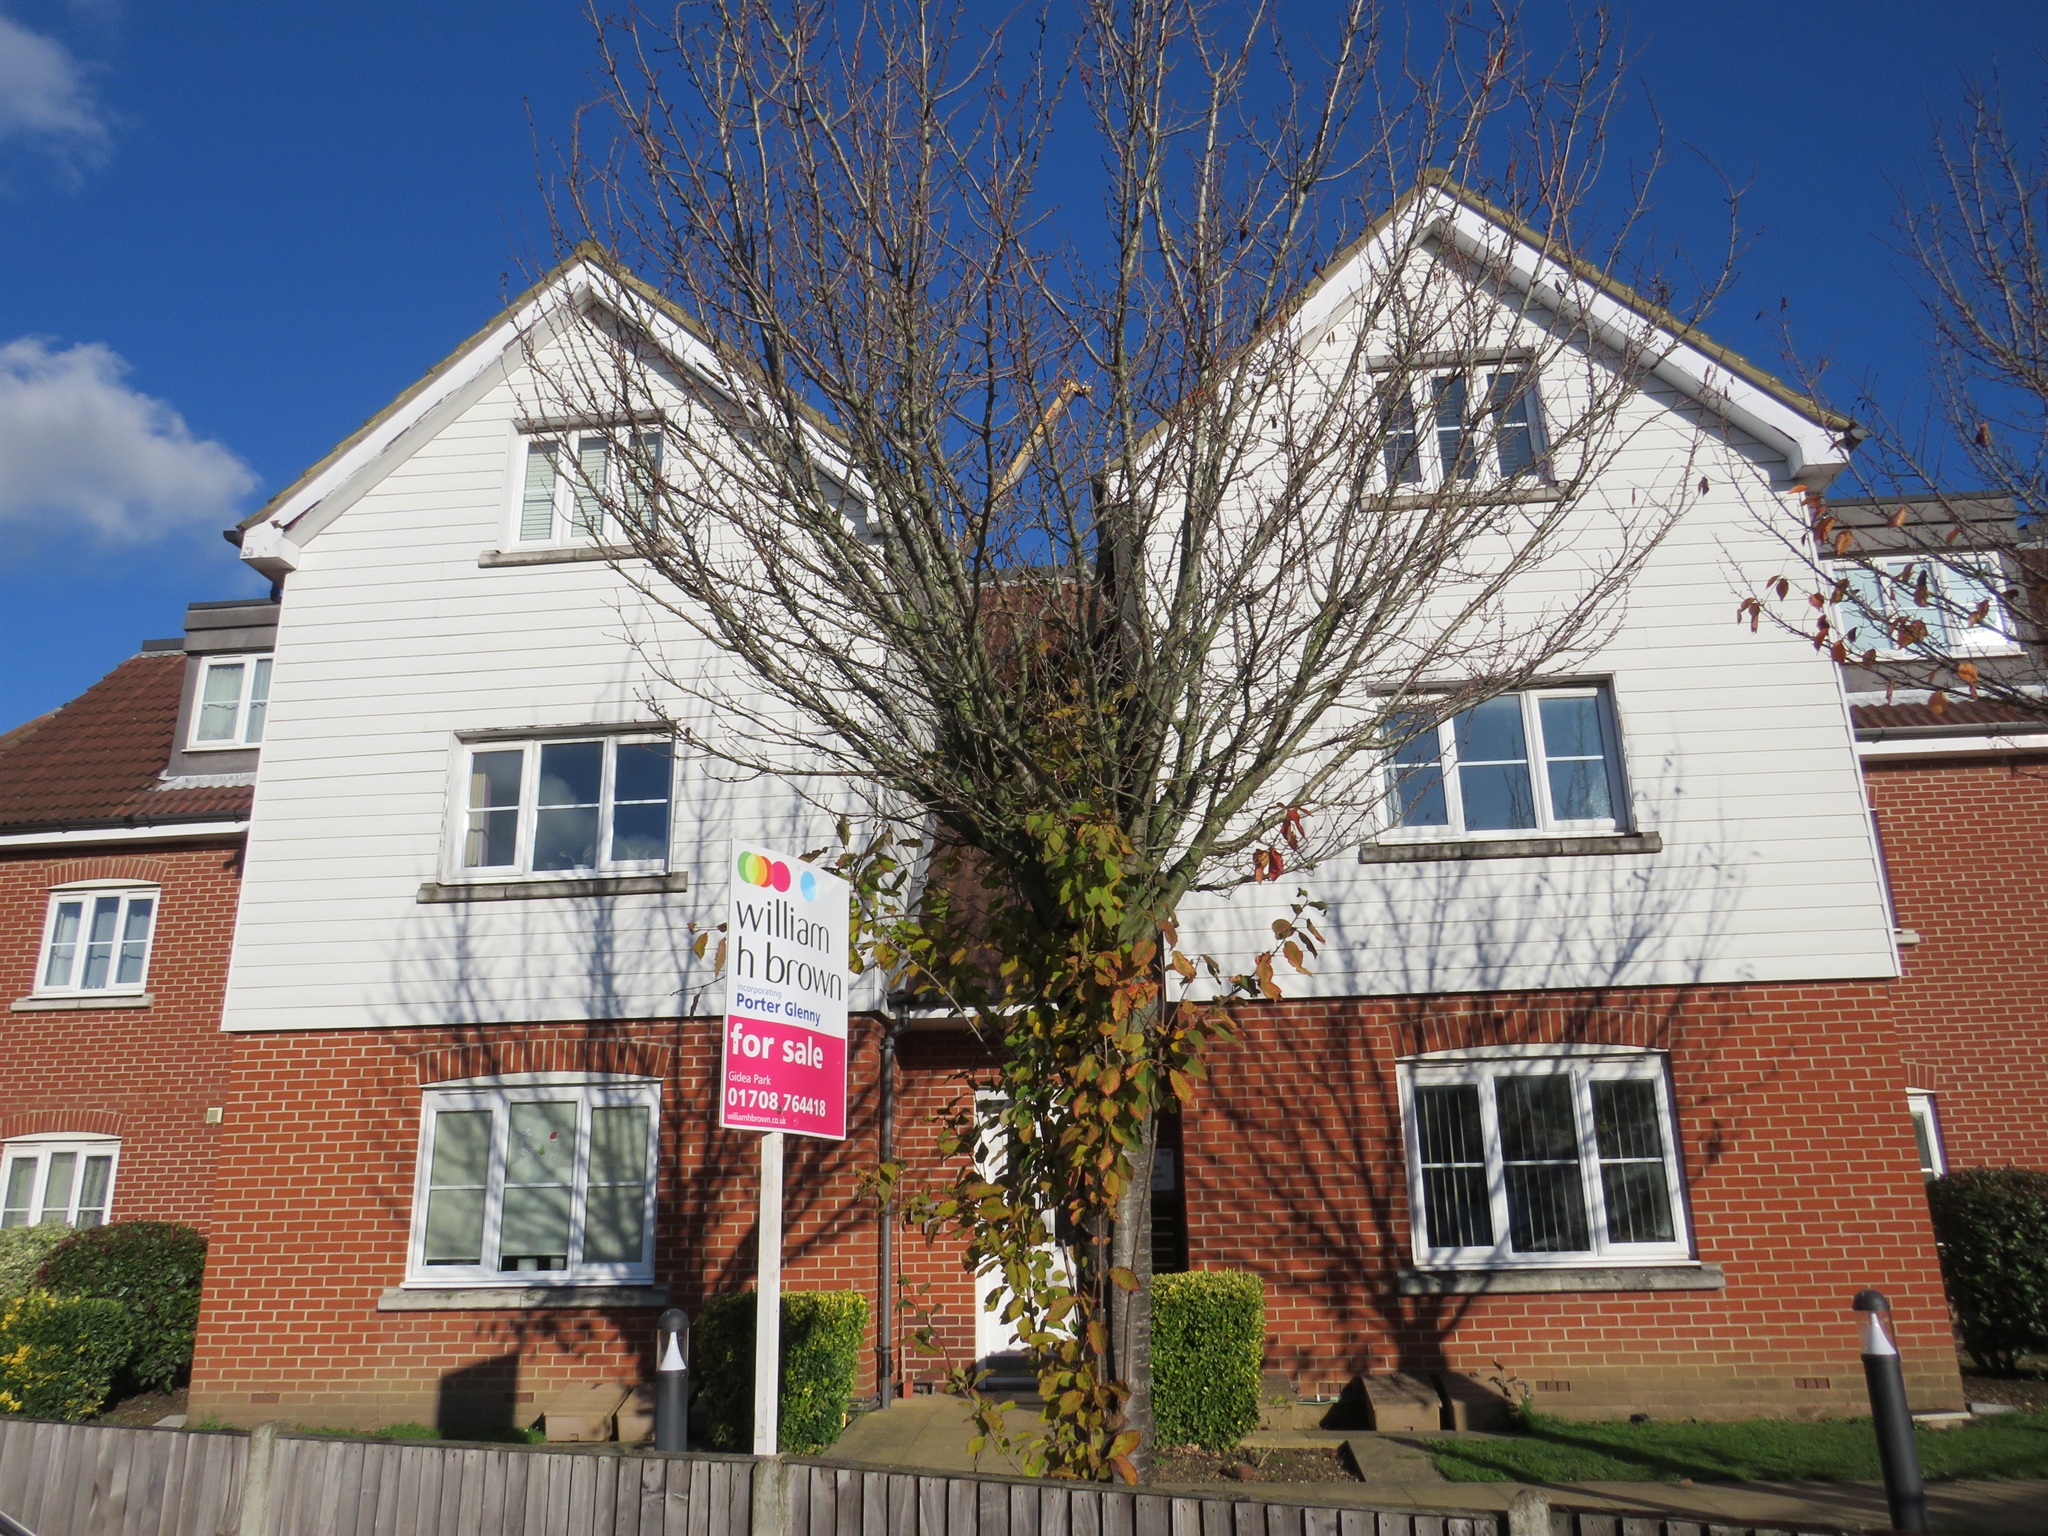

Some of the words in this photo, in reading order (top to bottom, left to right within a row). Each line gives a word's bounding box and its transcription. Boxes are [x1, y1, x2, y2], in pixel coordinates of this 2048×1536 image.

[736, 898, 829, 954] william
[737, 936, 754, 978] h
[766, 942, 841, 1000] brown
[736, 992, 780, 1014] Porter
[784, 1002, 820, 1026] Glenny
[730, 1022, 774, 1059] for
[782, 1036, 824, 1069] sale
[728, 1070, 751, 1084] Gidea
[754, 1074, 772, 1086] Park
[727, 1112, 786, 1124] williamhbrown.co.uk
[728, 1087, 778, 1110] 01708
[783, 1094, 826, 1117] 764418
